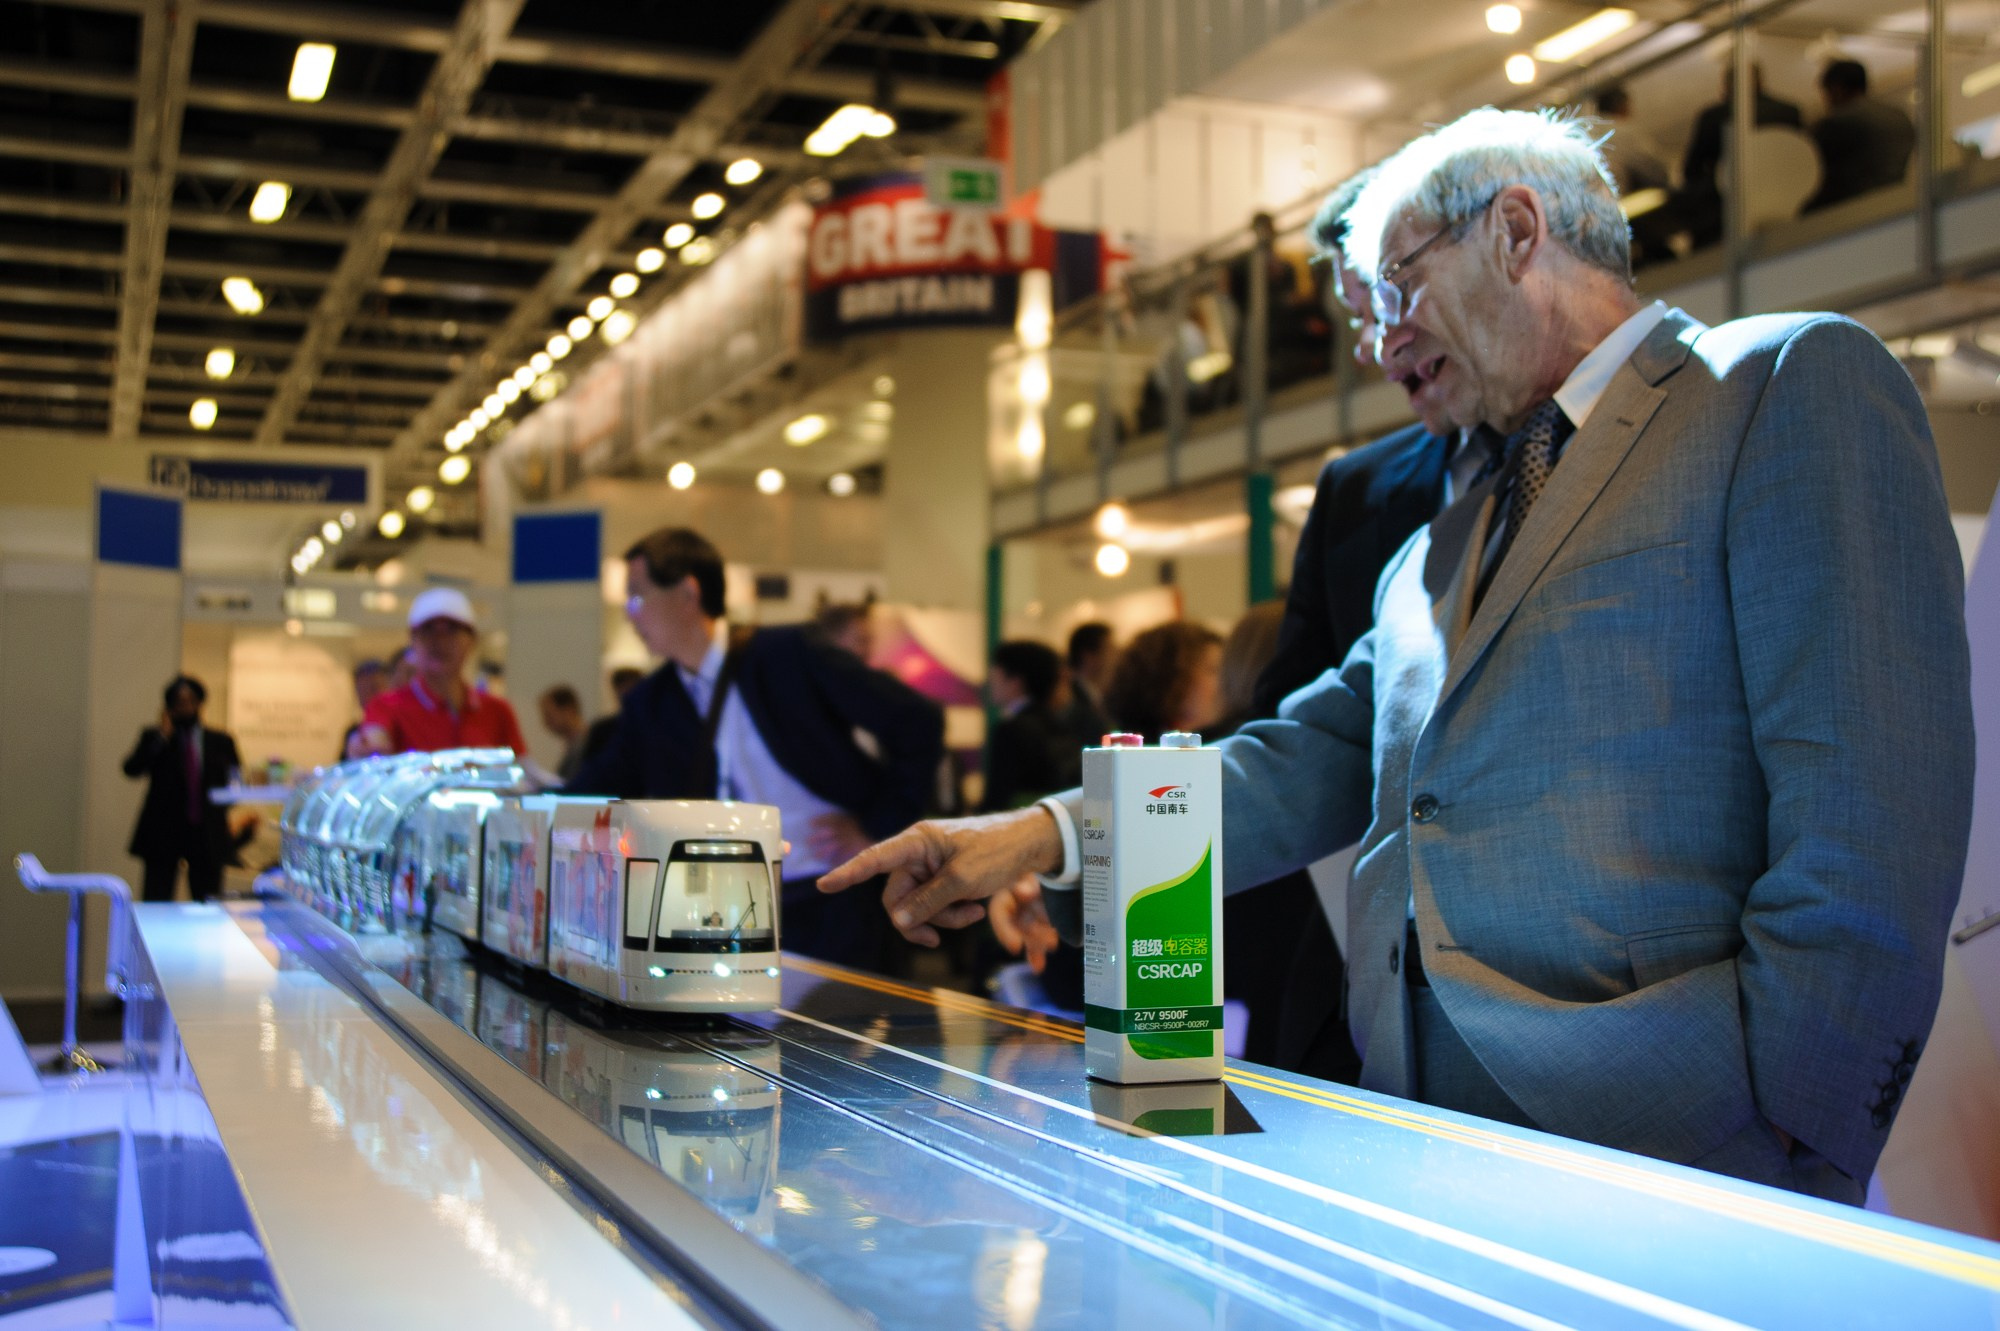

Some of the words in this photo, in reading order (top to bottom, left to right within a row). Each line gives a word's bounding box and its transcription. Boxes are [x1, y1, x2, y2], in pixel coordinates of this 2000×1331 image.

[811, 200, 1031, 277] GREAT
[1167, 791, 1187, 799] CSR
[1146, 803, 1189, 815] 中国南车
[1084, 855, 1111, 867] WARNING
[1132, 937, 1208, 957] 超级电容器
[1137, 963, 1203, 979] CSRCAP
[1134, 1011, 1156, 1021] 2.7V
[1158, 1010, 1188, 1020] 9500F
